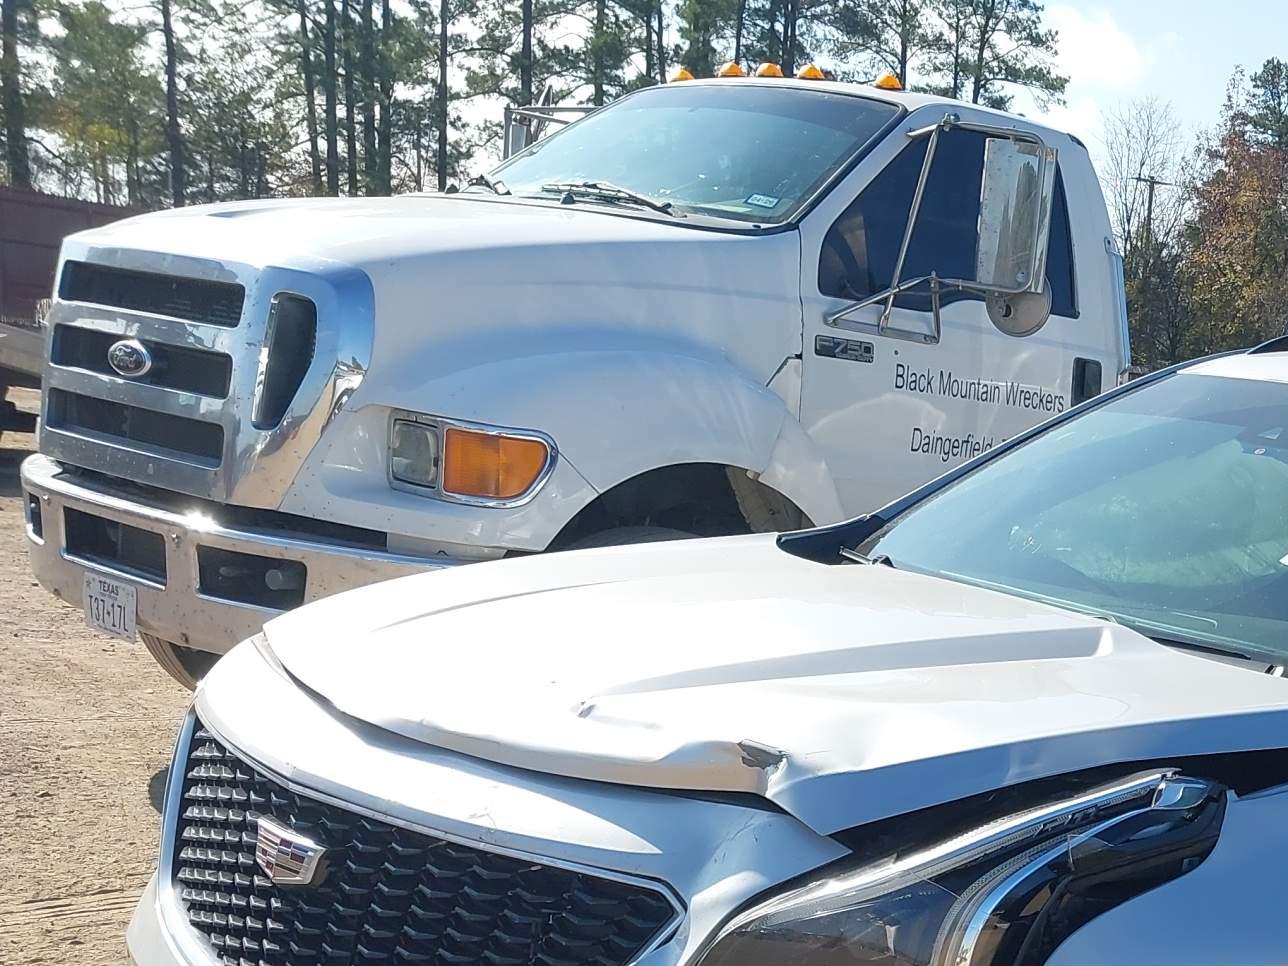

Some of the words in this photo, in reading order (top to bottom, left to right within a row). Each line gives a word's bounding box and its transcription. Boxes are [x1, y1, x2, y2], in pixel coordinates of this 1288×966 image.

[894, 362, 935, 395] Black
[938, 369, 1001, 405] Mountain
[1005, 380, 1066, 414] Wreckers
[910, 427, 994, 463] Daingerfield
[98, 579, 120, 597] TEXAS
